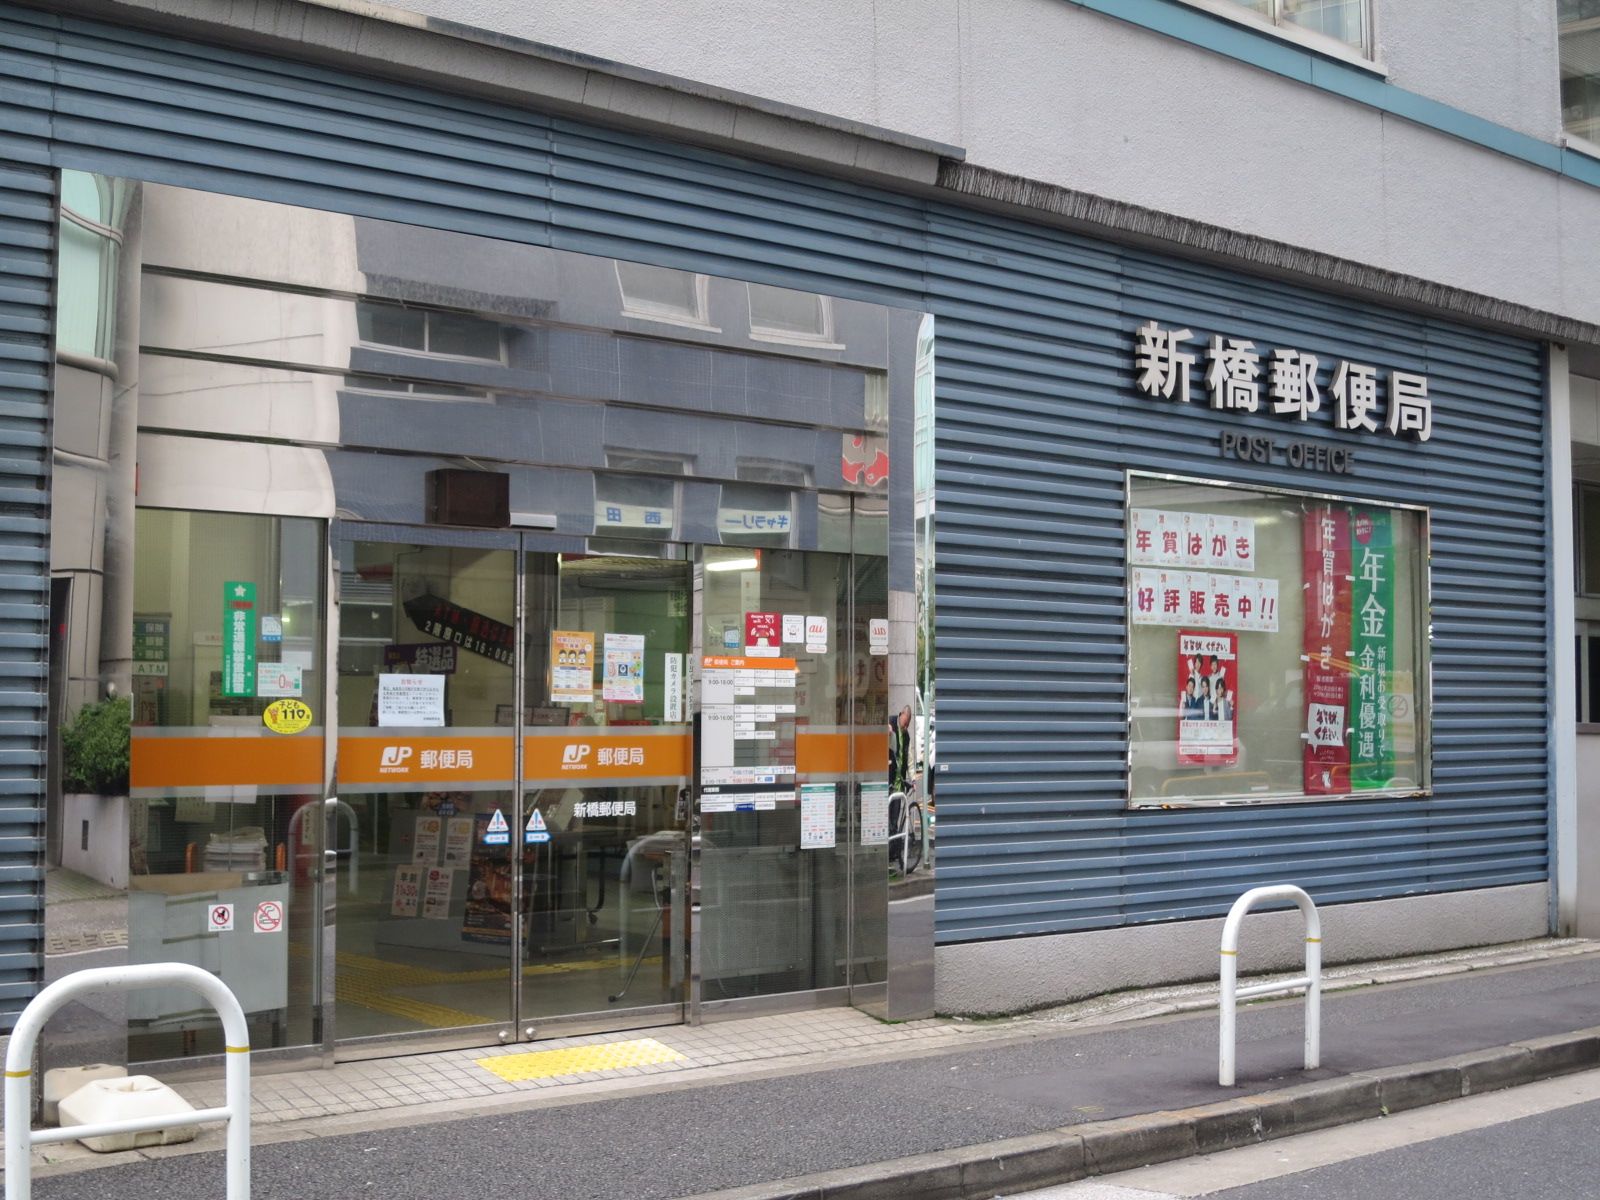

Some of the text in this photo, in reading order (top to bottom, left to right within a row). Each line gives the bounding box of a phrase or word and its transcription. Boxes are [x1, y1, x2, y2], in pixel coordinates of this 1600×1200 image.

[1135, 320, 1432, 442] 新橋郵便局
[1219, 430, 1355, 474] POST OFFICE
[1136, 529, 1251, 559] 年賀はがき
[1138, 587, 1275, 620] 好評販売中!!
[1359, 547, 1386, 637] 年金
[137, 664, 166, 673] ATM
[669, 656, 678, 719] 防犯カメラ設置店
[1358, 644, 1377, 758] 金利優遇
[278, 701, 300, 710] 子ども
[380, 746, 473, 769] JP 郵便局
[562, 744, 644, 766] JP 郵便局
[573, 800, 636, 818] 新橋郵便局
